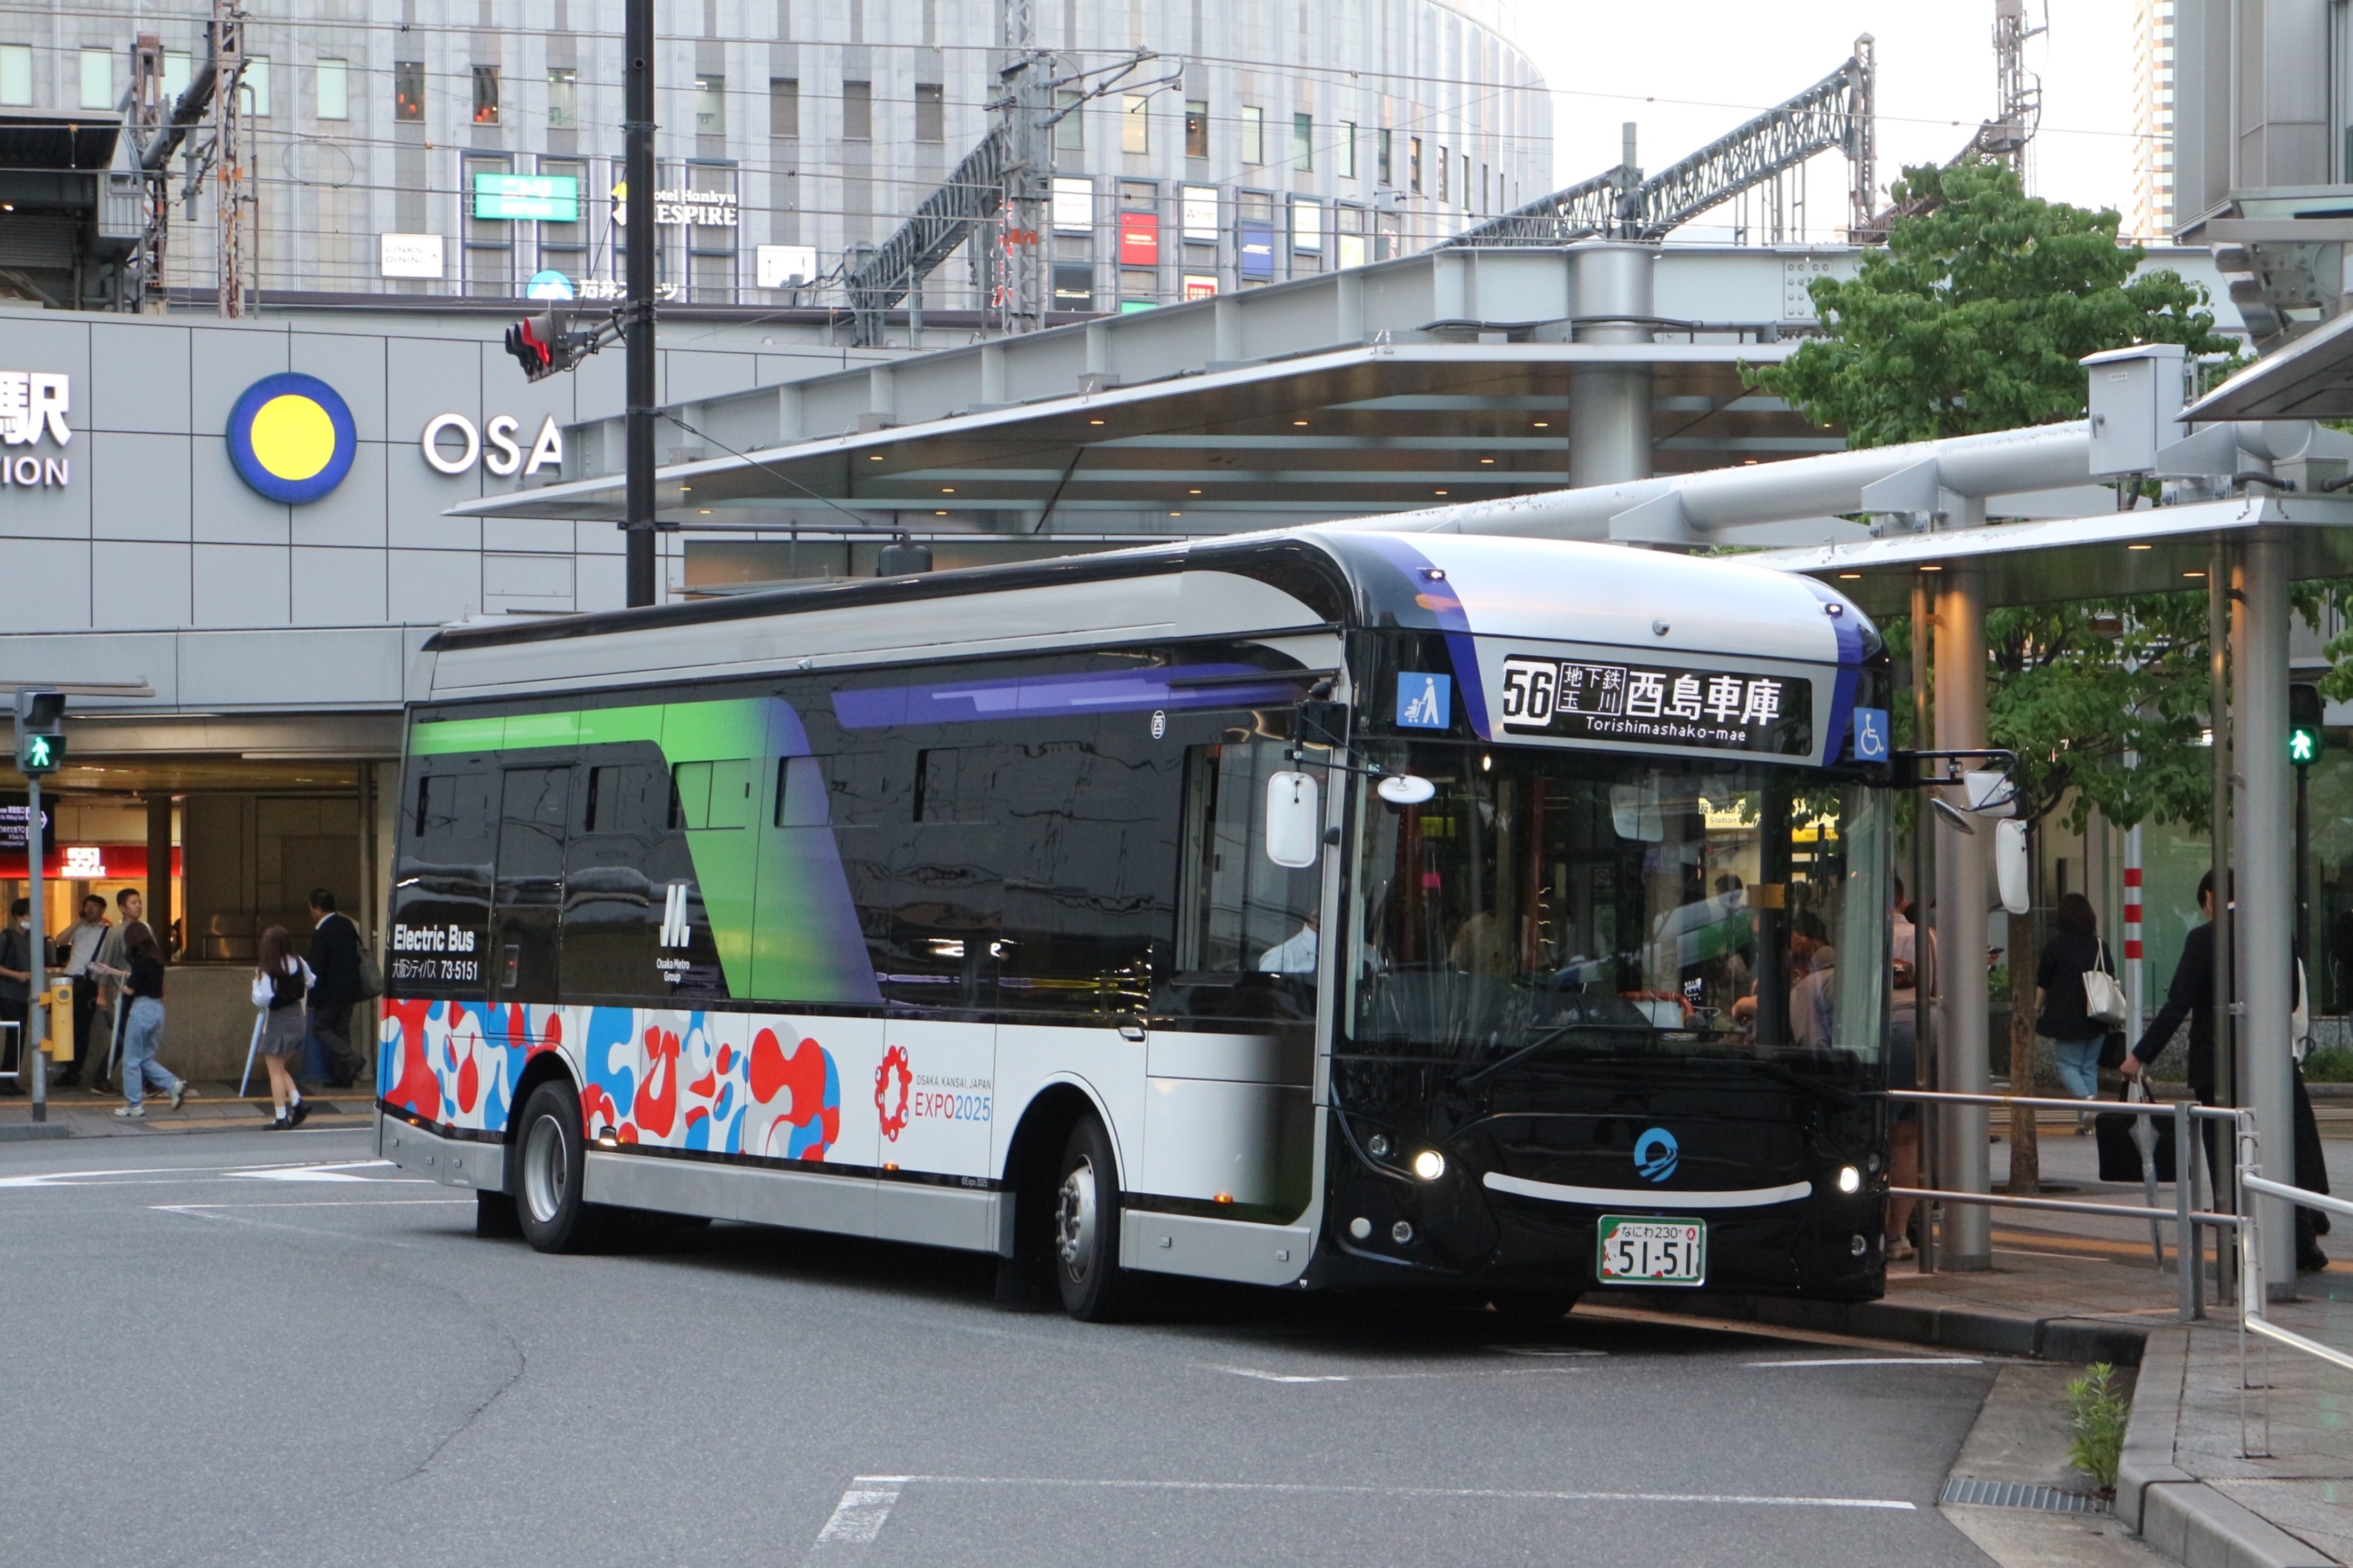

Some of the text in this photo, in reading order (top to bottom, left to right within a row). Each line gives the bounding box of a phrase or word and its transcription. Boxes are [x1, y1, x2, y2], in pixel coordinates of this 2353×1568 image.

[654, 189, 737, 206] otel Hankyu
[654, 204, 737, 225] ESPIRE
[421, 412, 562, 474] OSA
[1564, 667, 1621, 691] 地下鉄
[1503, 668, 1553, 718] 56
[1626, 671, 1782, 725] 酉島車庫
[1586, 716, 1746, 742] Torishimashako-mae
[394, 924, 475, 952] Electric Bus
[441, 960, 478, 980] 73-5151
[657, 958, 690, 970] Osaka Metro
[664, 971, 682, 984] Group
[917, 1075, 992, 1090] OSAKA, KANSAI, JAPAN
[1619, 1240, 1692, 1276] 51-51
